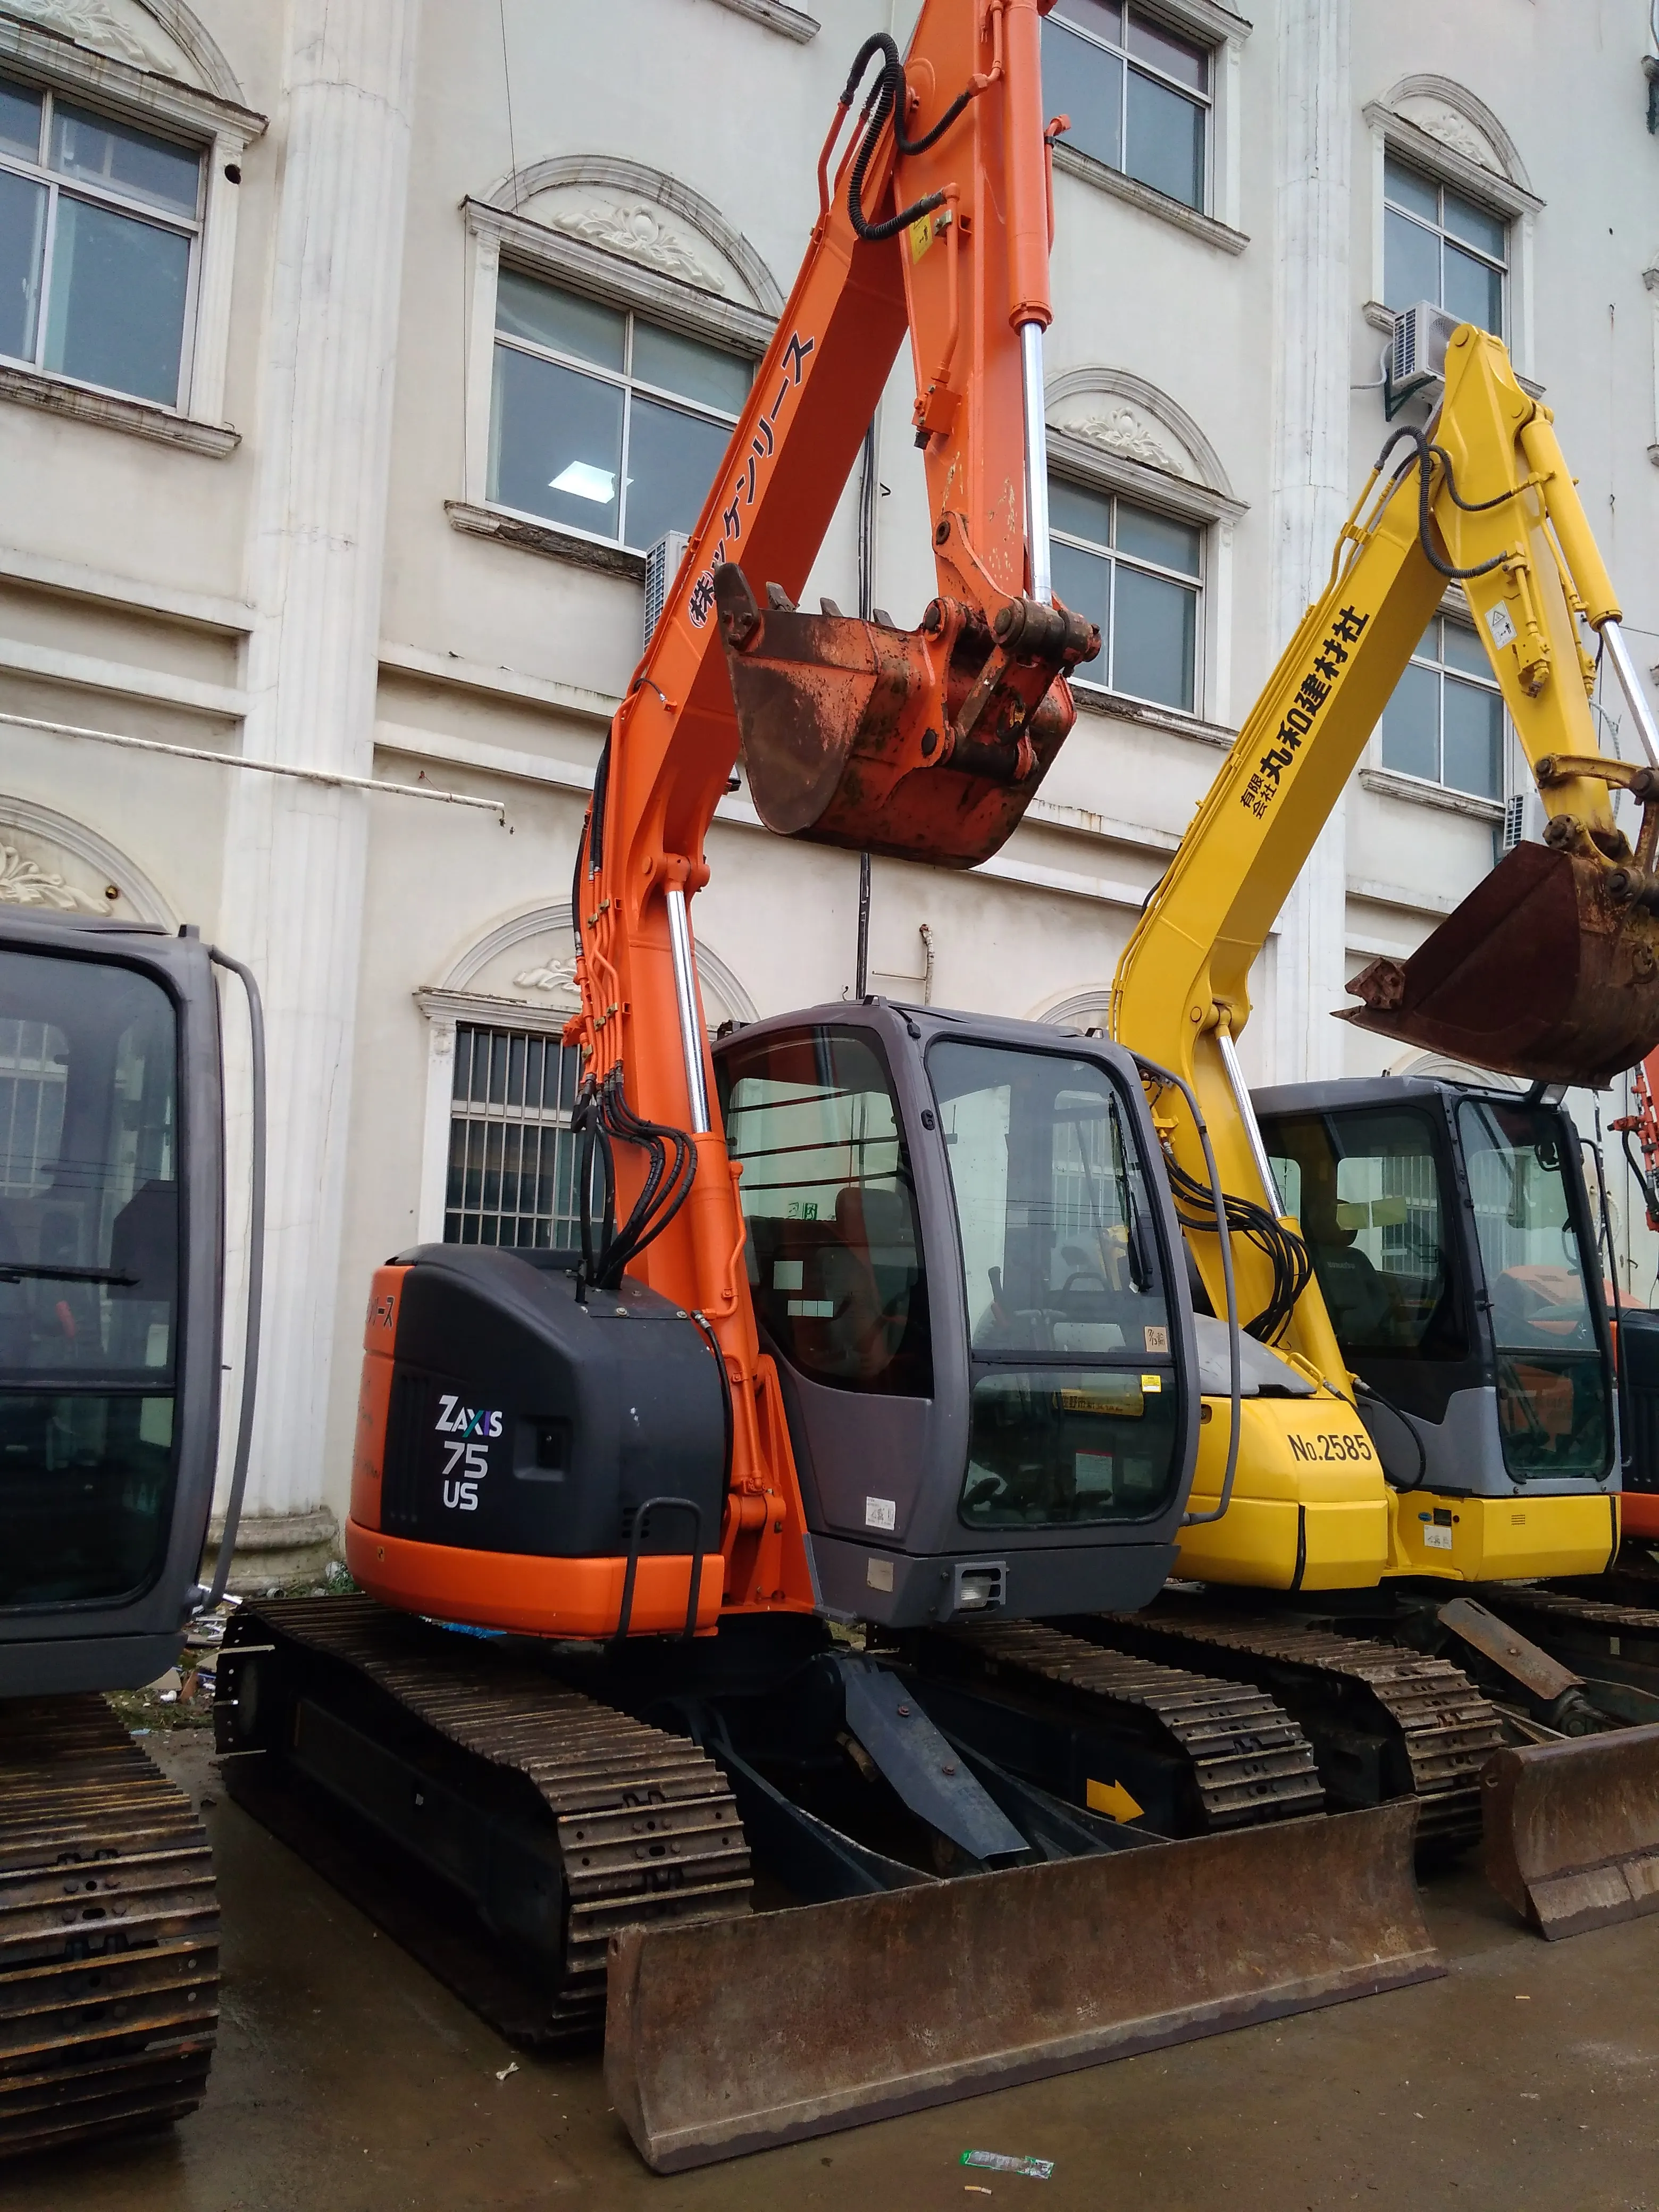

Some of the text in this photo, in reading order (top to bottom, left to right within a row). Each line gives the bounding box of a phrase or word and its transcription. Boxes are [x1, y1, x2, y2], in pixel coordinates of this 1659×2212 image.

[1260, 605, 1370, 785] 丸和建材社
[435, 1395, 502, 1438] ZAXIS
[442, 1440, 489, 1479] 75
[1287, 1435, 1372, 1461] No.2585
[443, 1480, 479, 1511] US
